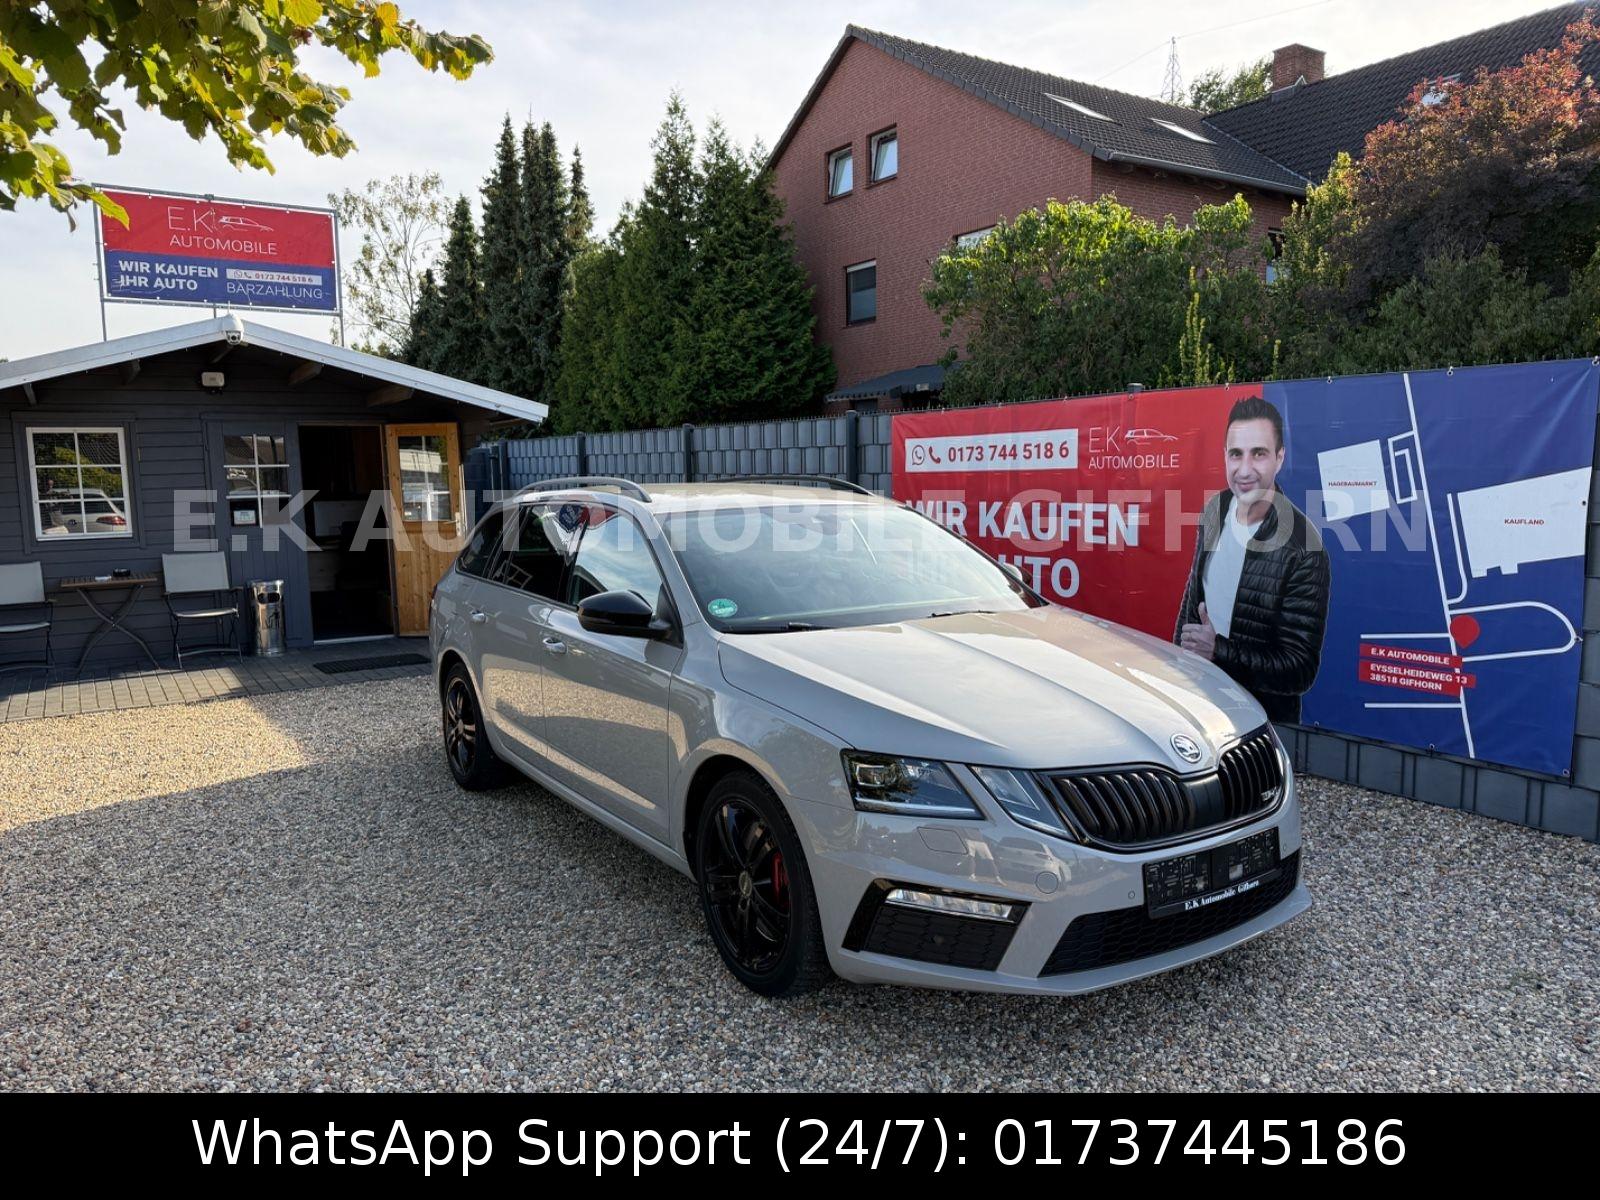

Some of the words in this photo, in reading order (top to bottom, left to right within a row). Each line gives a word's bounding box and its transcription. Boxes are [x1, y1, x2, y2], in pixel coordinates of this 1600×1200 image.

[167, 206, 213, 233] E.K
[169, 234, 278, 255] AUTOMOBILE
[119, 260, 150, 273] WIR
[155, 263, 219, 278] KAUFEN
[255, 272, 275, 281] 0173
[277, 274, 291, 282] 744
[120, 275, 149, 288] IHR
[153, 277, 198, 291] AUTO
[226, 281, 323, 299] BARZAHLUNG
[1088, 425, 1121, 453] E.K
[948, 446, 984, 463] 0173
[989, 443, 1018, 461] 744
[1023, 442, 1054, 460] 518
[1059, 440, 1070, 458] 6
[1088, 453, 1180, 470] AUTOMOBILE
[978, 501, 1140, 547] KAUFEN
[1370, 647, 1386, 657] E.K
[1387, 650, 1451, 666] AUTOMOBILE
[1370, 663, 1453, 682] EYSSELHEIDEWEG
[1456, 675, 1468, 685] 13
[1370, 673, 1398, 684] 38518
[1399, 677, 1443, 691] GIFHORN
[1201, 889, 1236, 905] Automobile
